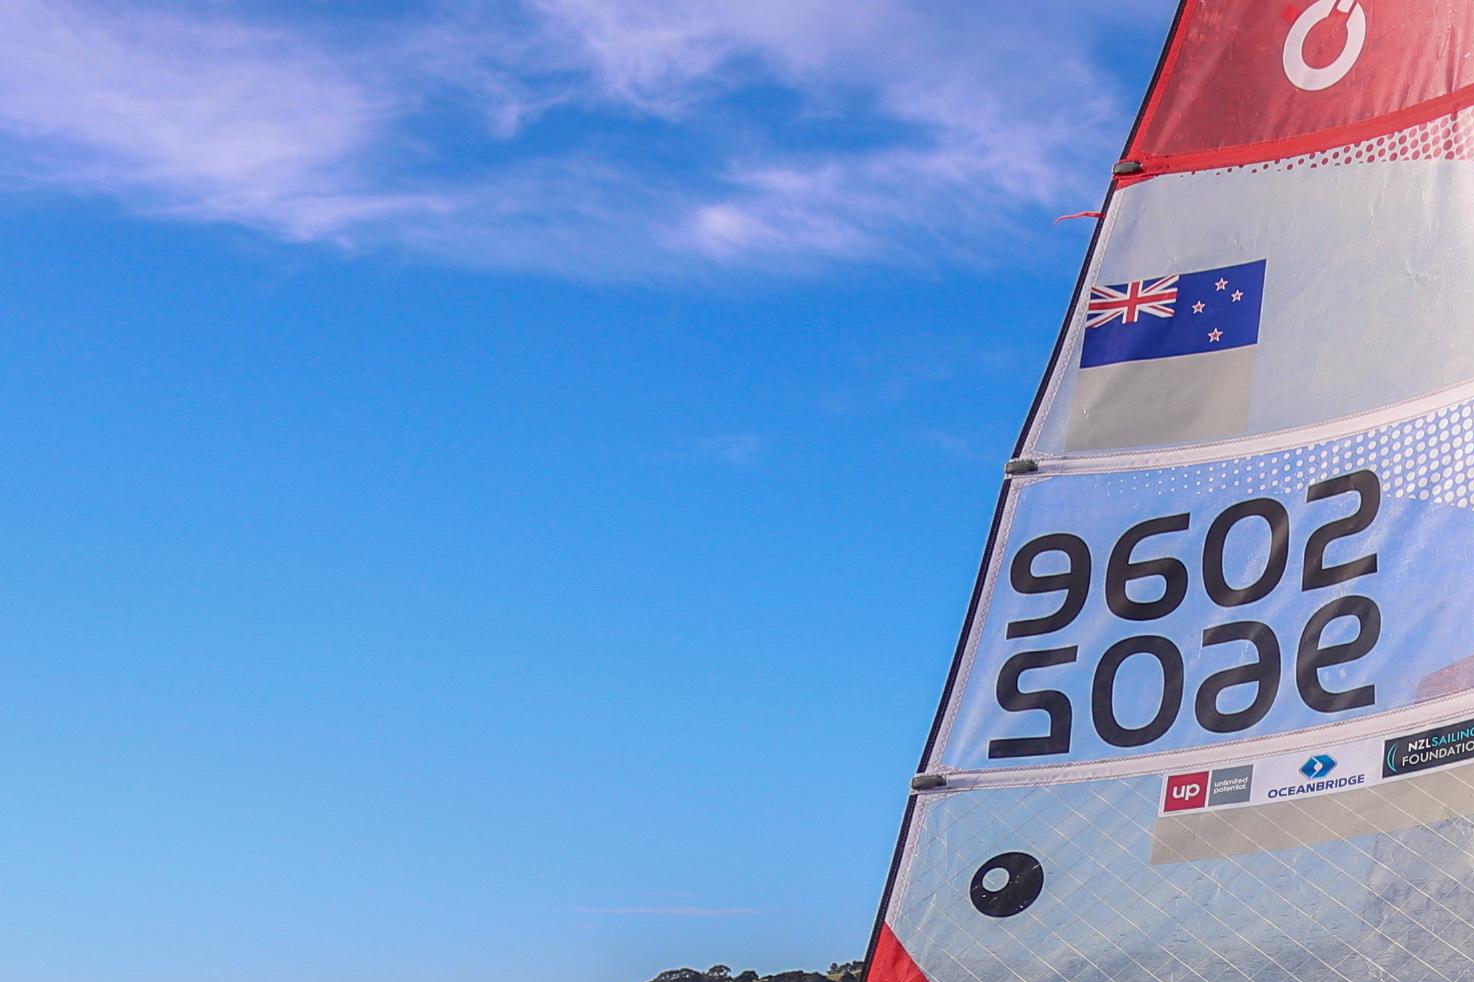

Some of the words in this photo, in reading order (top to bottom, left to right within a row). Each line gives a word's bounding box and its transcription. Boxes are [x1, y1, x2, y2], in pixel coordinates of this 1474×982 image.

[1006, 469, 1382, 640] 9602
[1172, 783, 1201, 801] up
[1214, 776, 1249, 787] unlimited
[1267, 773, 1366, 800] OCEANBRIDGE
